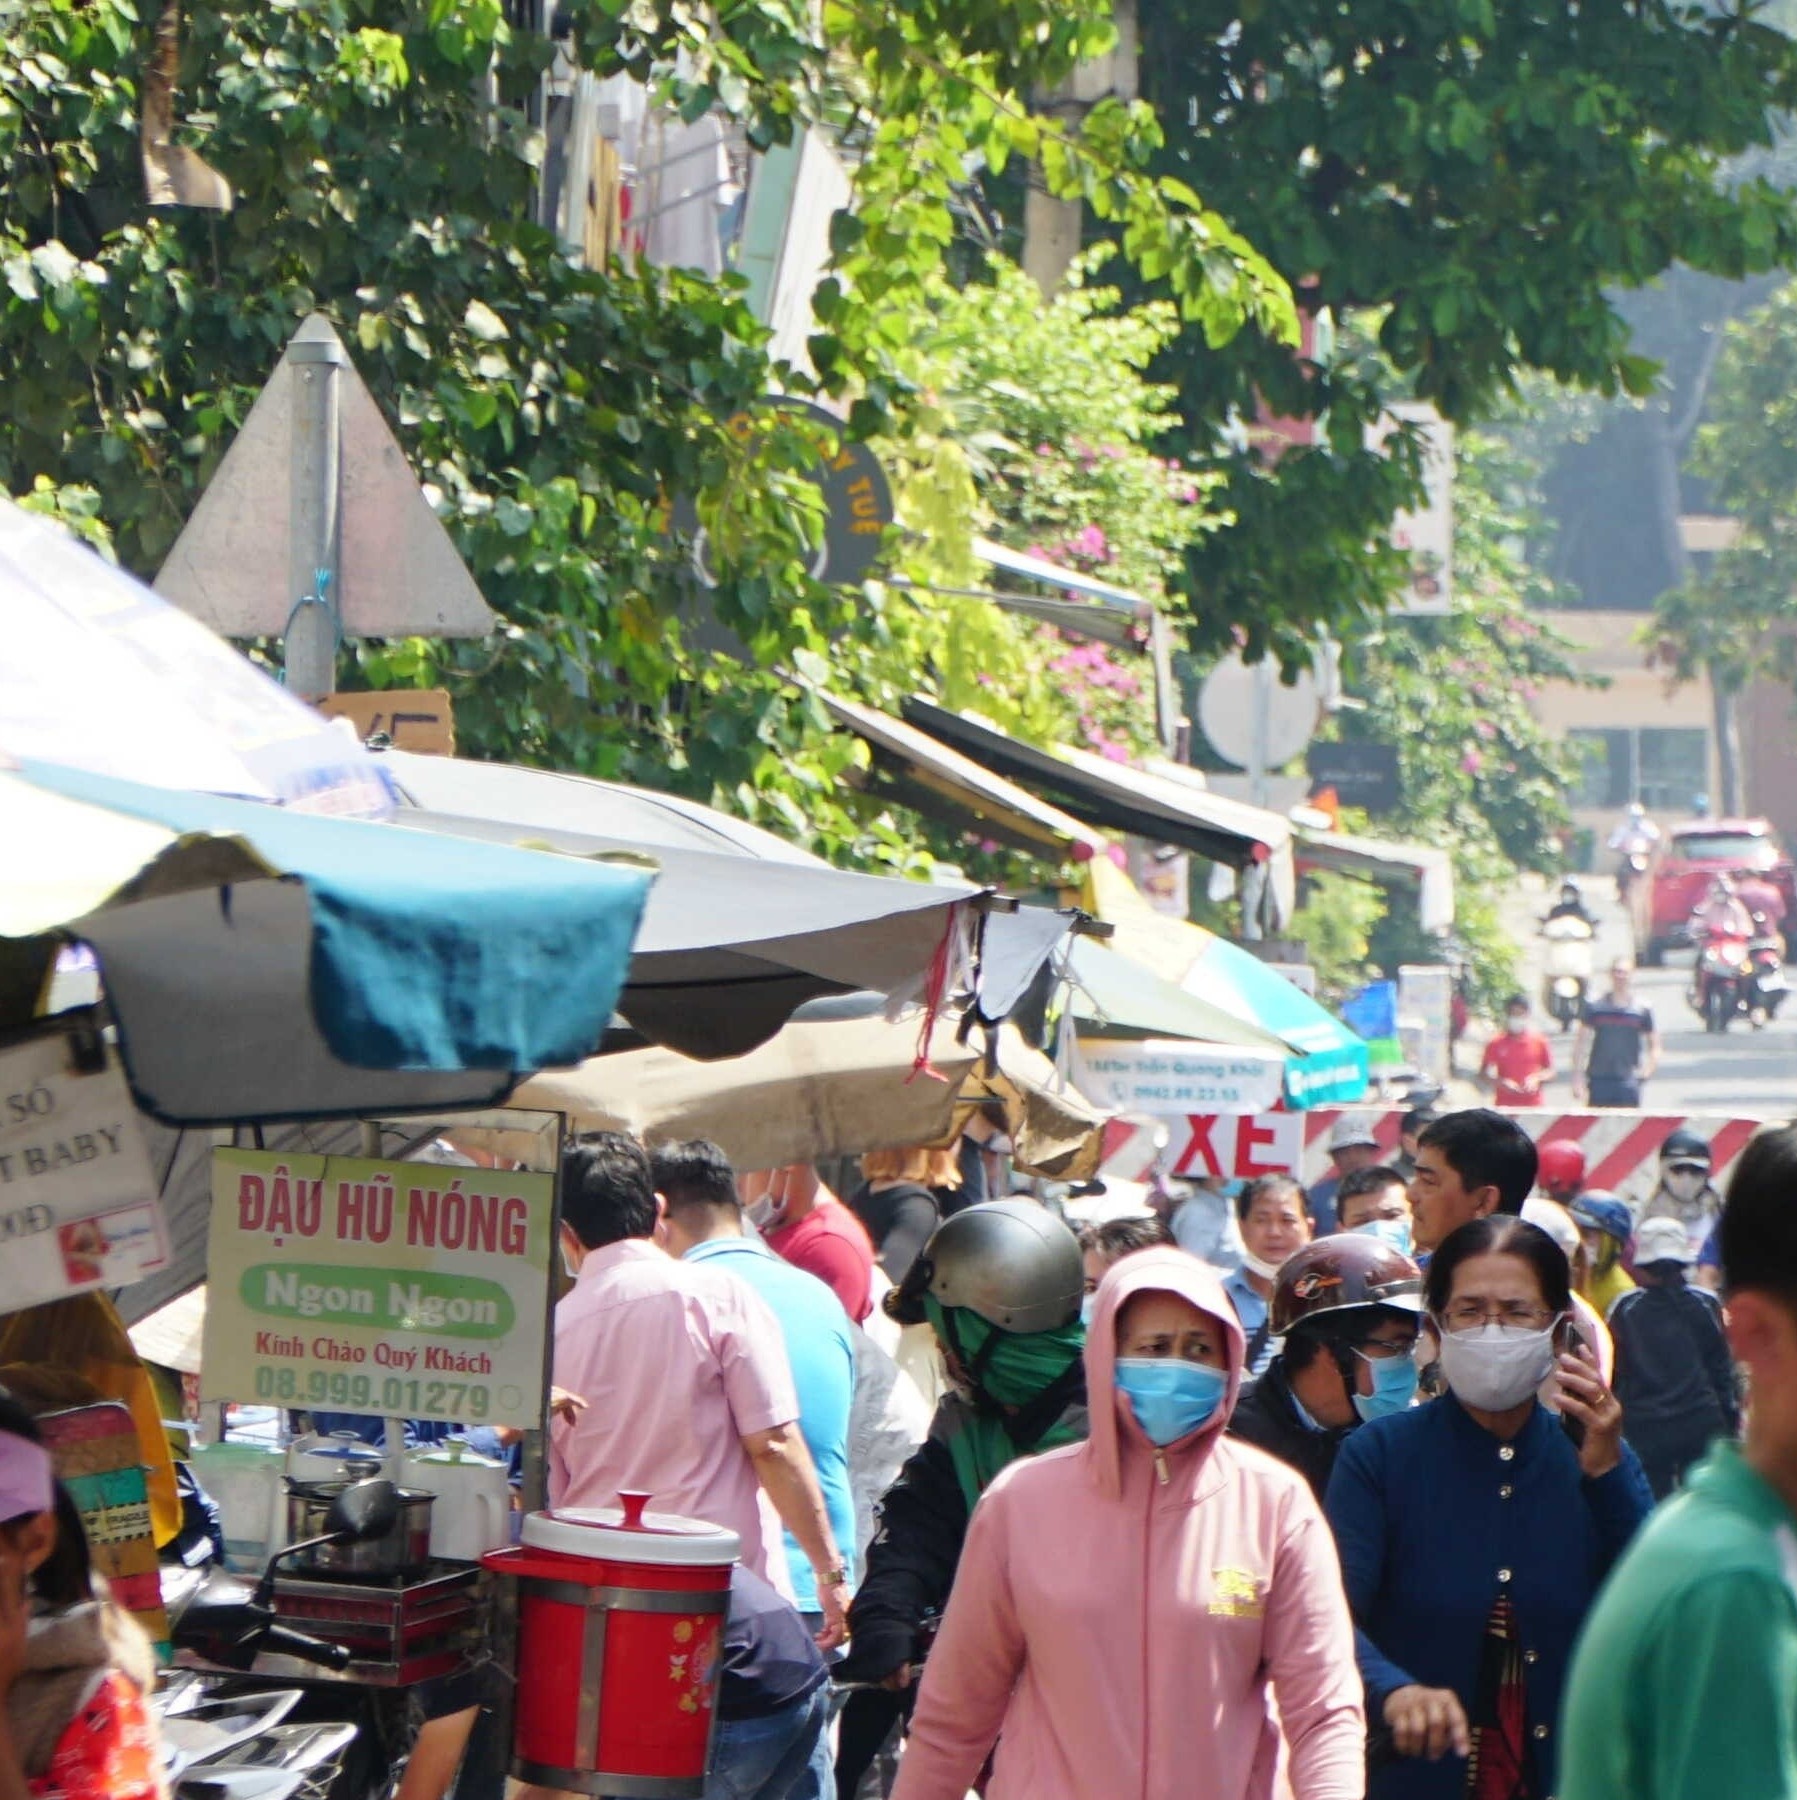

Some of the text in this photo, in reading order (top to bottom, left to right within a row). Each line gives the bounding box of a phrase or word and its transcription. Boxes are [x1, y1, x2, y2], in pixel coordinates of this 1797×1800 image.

[26, 1124, 122, 1176] BABY
[238, 1165, 528, 1256] ĐẬU HŨ NÓNG
[264, 1270, 498, 1327] Ngon Ngon
[373, 1342, 418, 1371] Quý
[424, 1346, 492, 1375] Khách
[255, 1365, 489, 1418] 08.999.01279
